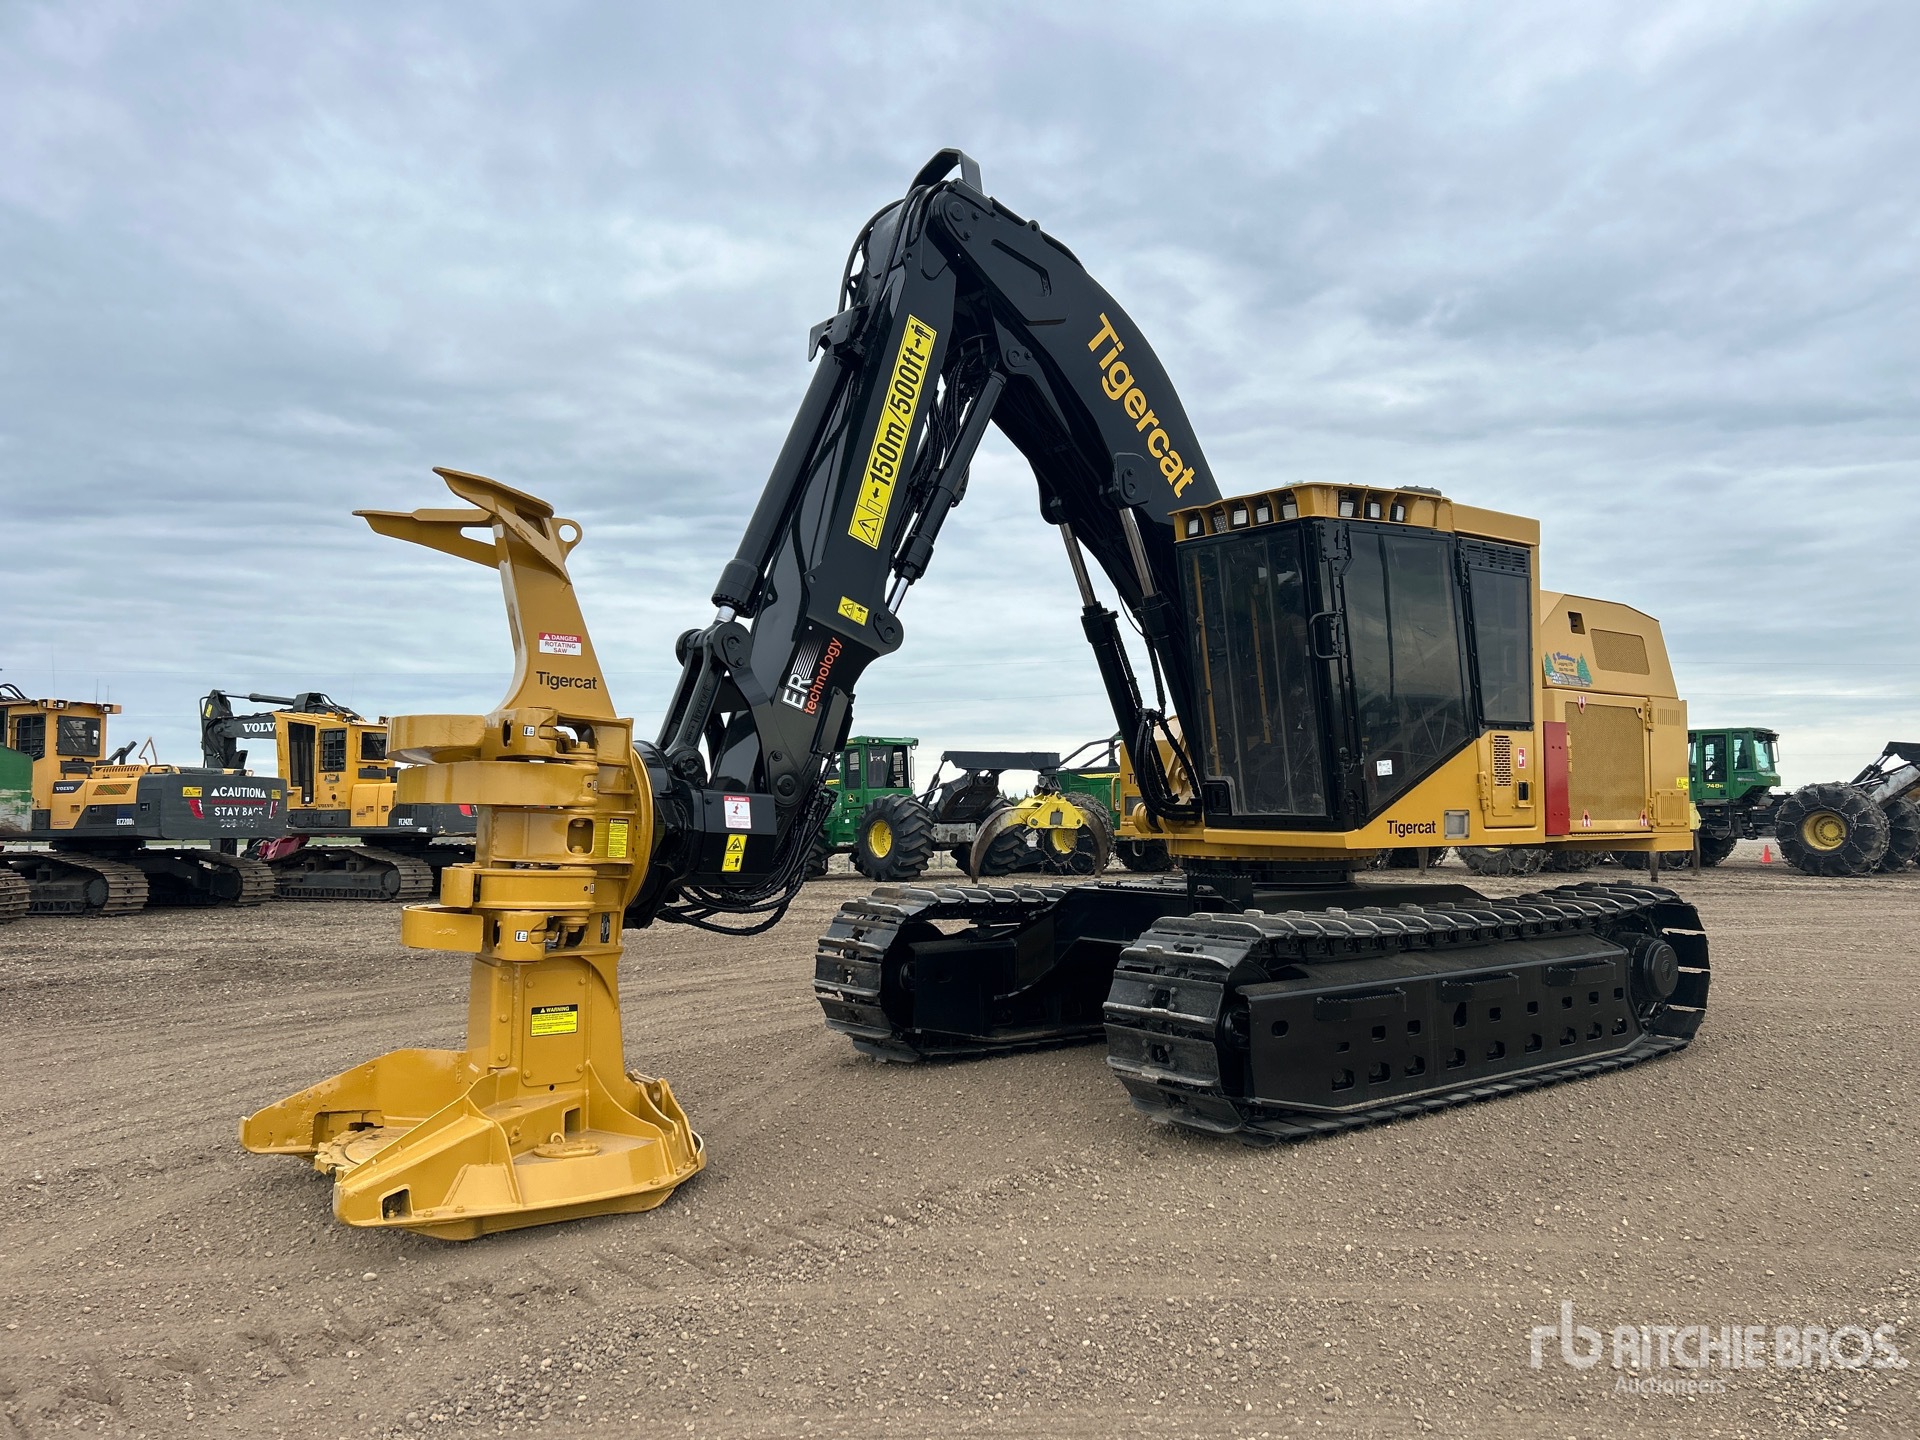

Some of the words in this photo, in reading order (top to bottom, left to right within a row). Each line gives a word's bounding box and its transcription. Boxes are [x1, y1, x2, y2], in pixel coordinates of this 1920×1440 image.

[1088, 312, 1195, 498] Tigercat
[869, 346, 925, 486] 150m/500ft
[544, 640, 576, 649] ROTATING
[551, 634, 578, 642] DANGER
[536, 671, 597, 690] Tigercat
[803, 637, 843, 715] technology
[782, 673, 814, 709] ER
[243, 722, 276, 733] VOLV
[219, 786, 261, 798] CAUTION
[214, 806, 240, 816] STAY
[1387, 819, 1436, 838] Tigercat
[546, 1005, 570, 1013] WARNING
